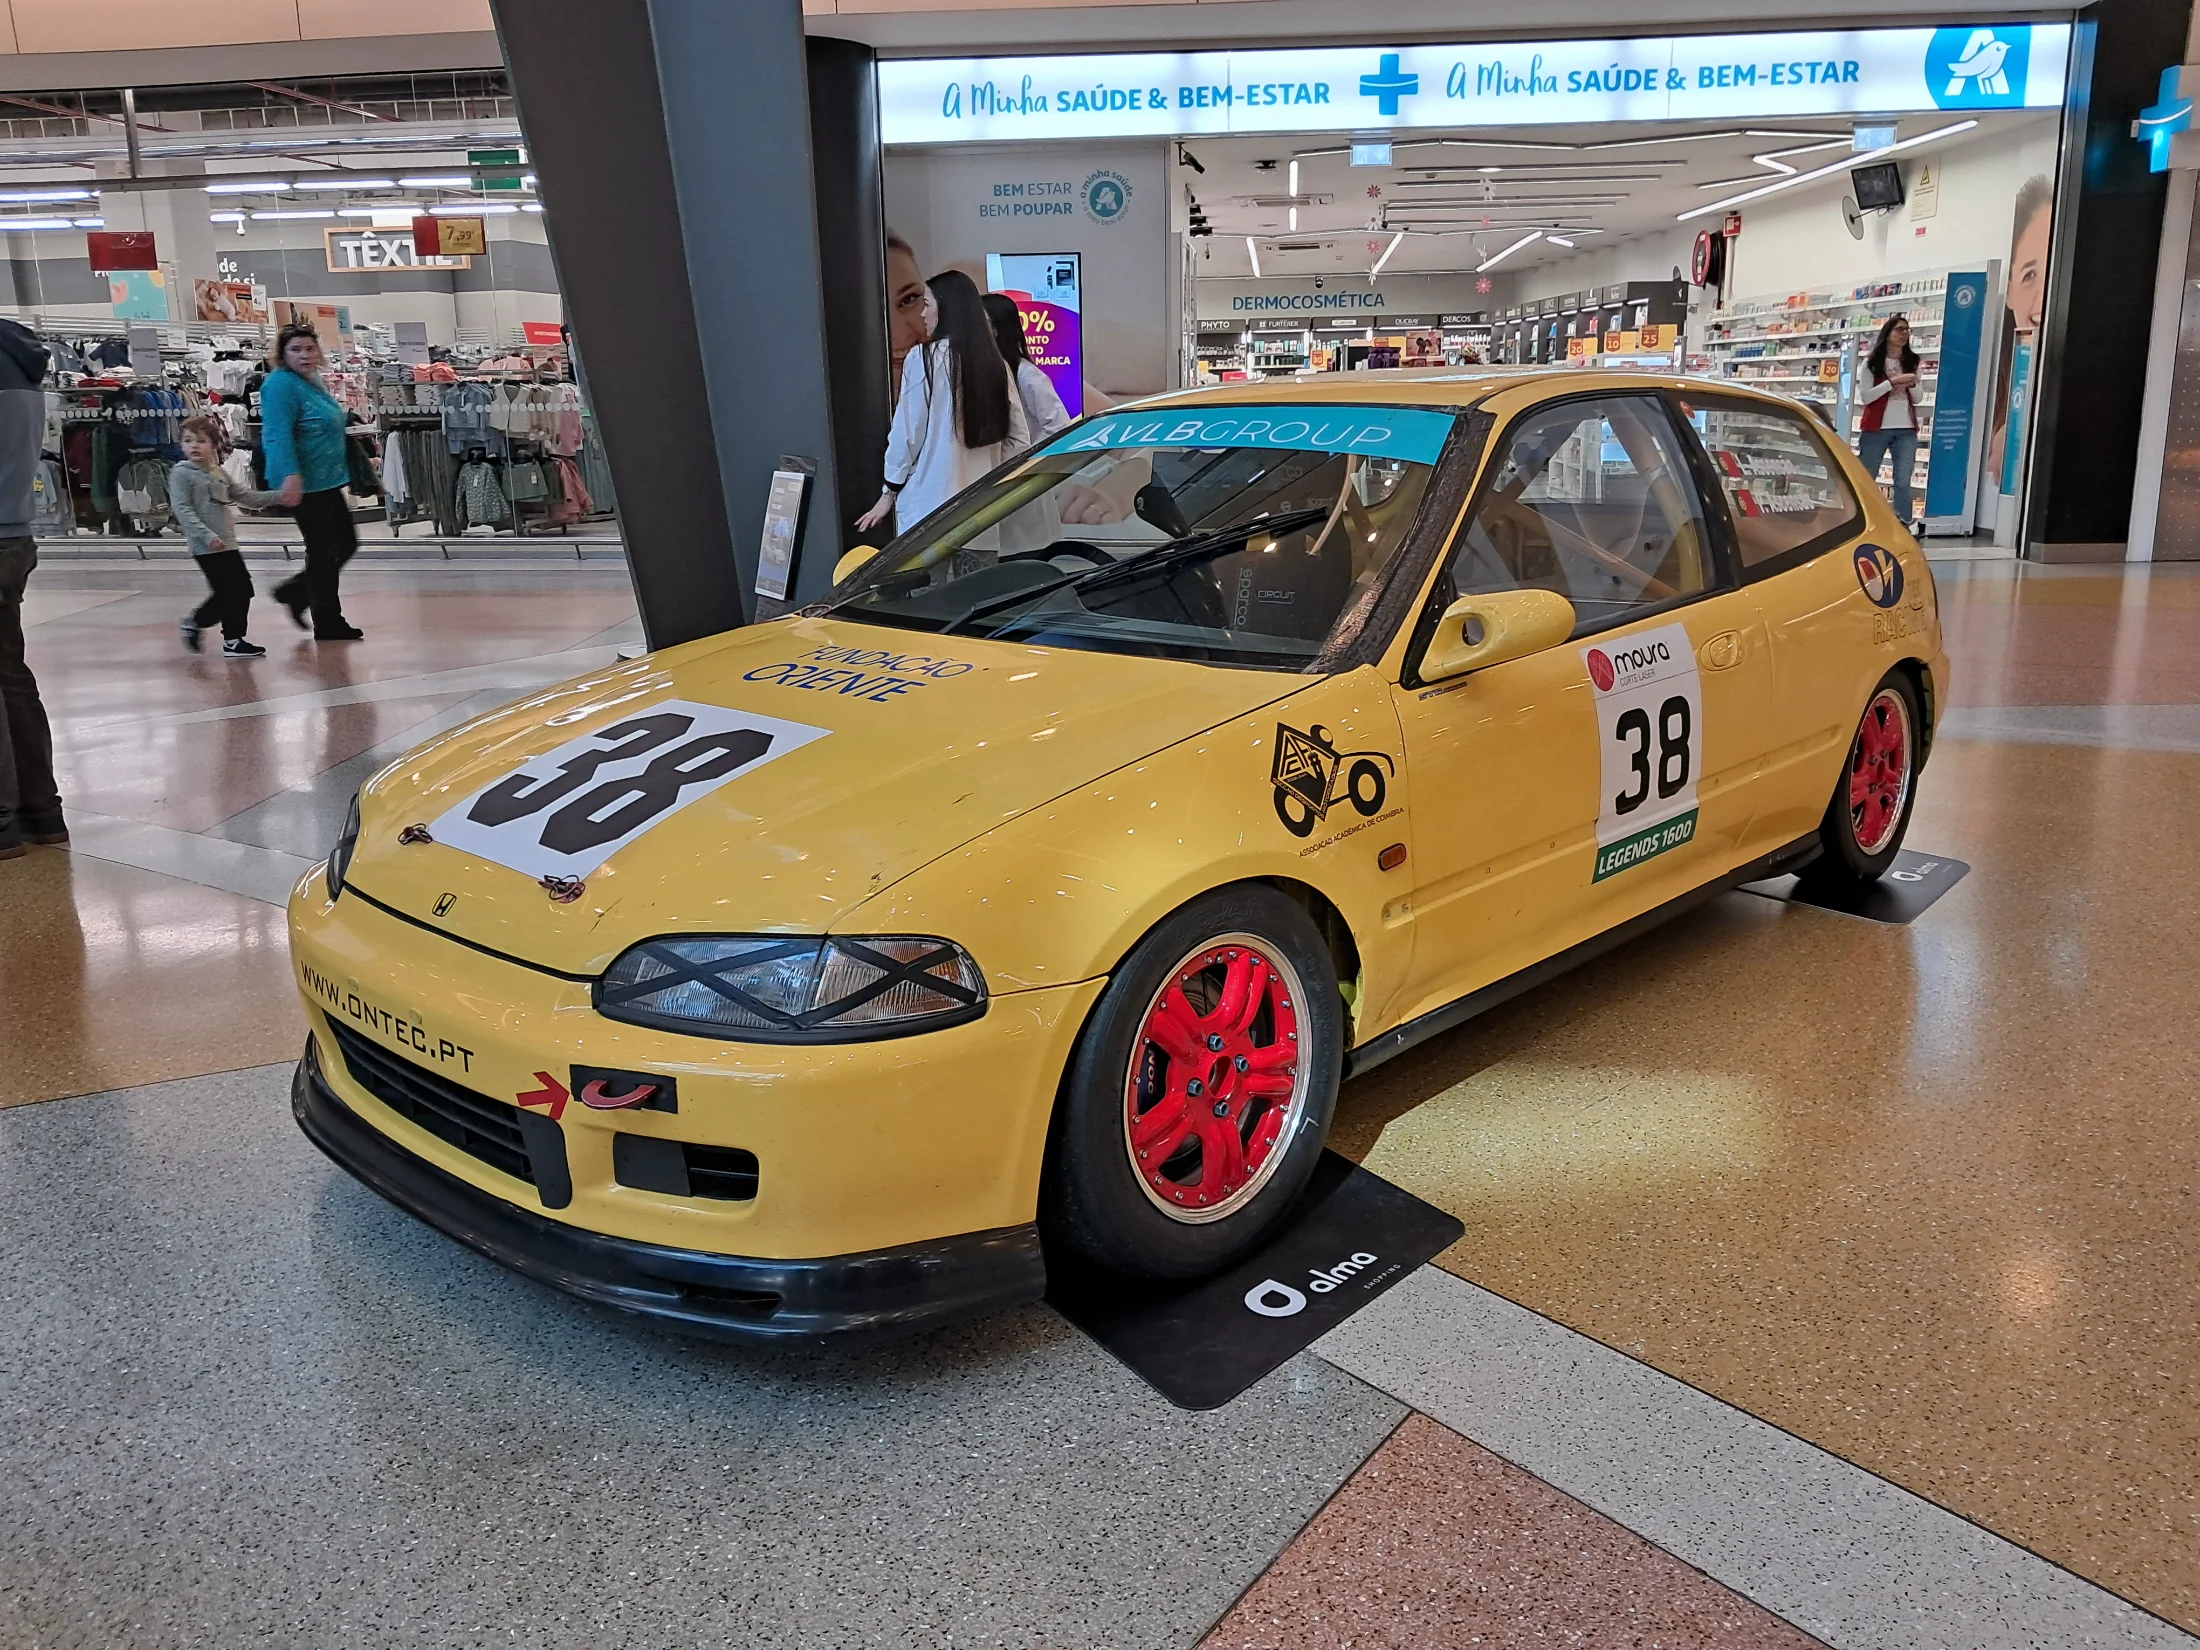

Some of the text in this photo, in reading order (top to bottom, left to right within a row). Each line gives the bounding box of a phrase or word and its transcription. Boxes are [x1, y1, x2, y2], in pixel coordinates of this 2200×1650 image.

[1476, 54, 1559, 96] Minha
[1566, 61, 1659, 93] SAÚDE
[1665, 67, 1687, 91] &
[1697, 59, 1860, 88] BEM-ESTAR
[971, 74, 1049, 116] Minha
[1056, 83, 1142, 113] SAÚDE
[1147, 88, 1168, 111] &
[1178, 82, 1331, 109] BEM-ESTAR
[993, 182, 1072, 197] BEM ESTAR
[1083, 169, 1110, 192] minha
[1111, 170, 1133, 198] saúde
[979, 202, 1073, 218] BEM POUPAR
[1232, 291, 1385, 311] DERMOCOSMÉTICA
[1443, 315, 1471, 323] DERCOS
[1570, 345, 1583, 354] 20
[1607, 341, 1619, 349] 10
[1643, 335, 1657, 344] 25
[1035, 356, 1071, 366] MARCA
[1312, 356, 1323, 364] 30
[1117, 420, 1392, 449] VLBGROUP
[1257, 590, 1296, 599] CIRCUIT
[797, 645, 974, 678] FUNDAÇÃO
[1614, 641, 1671, 675] moura
[743, 663, 928, 702] ORIENTE
[1619, 668, 1657, 687] CORTE LASER
[1615, 695, 1691, 816] 38
[466, 712, 775, 856] 38
[1366, 819, 1376, 828] DE
[1375, 807, 1405, 823] COIMBRA
[1598, 819, 1692, 875] LEGENDS 1600
[301, 960, 475, 1073] WWW.ONTEC.PT
[1308, 1252, 1379, 1293] alma
[1363, 1264, 1402, 1290] SHOPPING
